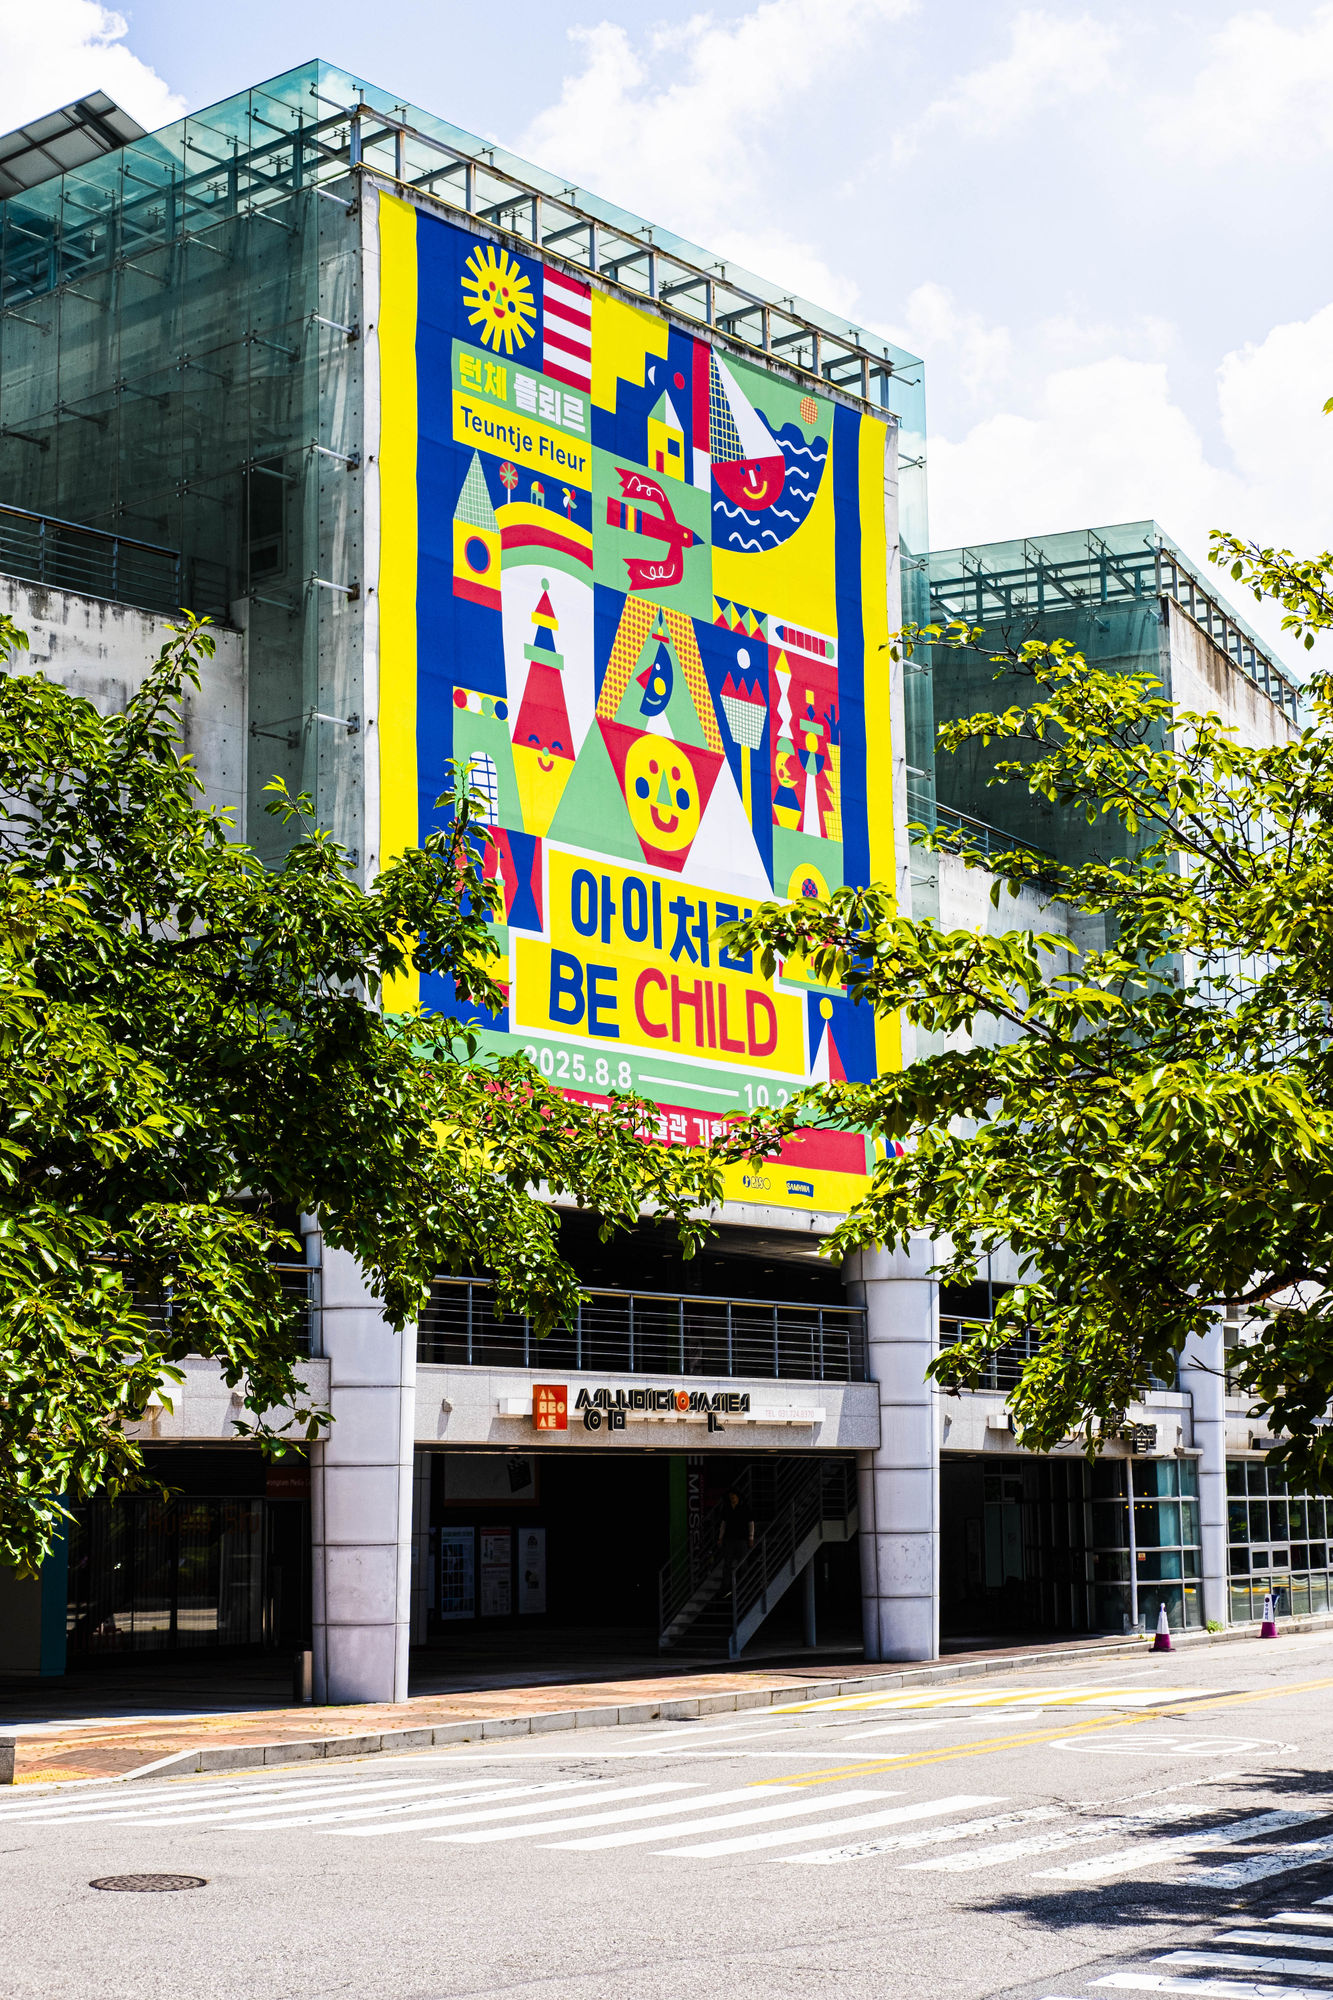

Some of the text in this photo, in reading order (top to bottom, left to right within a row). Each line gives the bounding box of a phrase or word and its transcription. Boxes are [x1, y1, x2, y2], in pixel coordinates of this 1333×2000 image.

[459, 352, 586, 433] 턴체 플뢰르
[460, 405, 586, 473] Teuntje Fleur
[549, 948, 778, 1057] BE CHILD
[743, 1083, 801, 1115] 10.2
